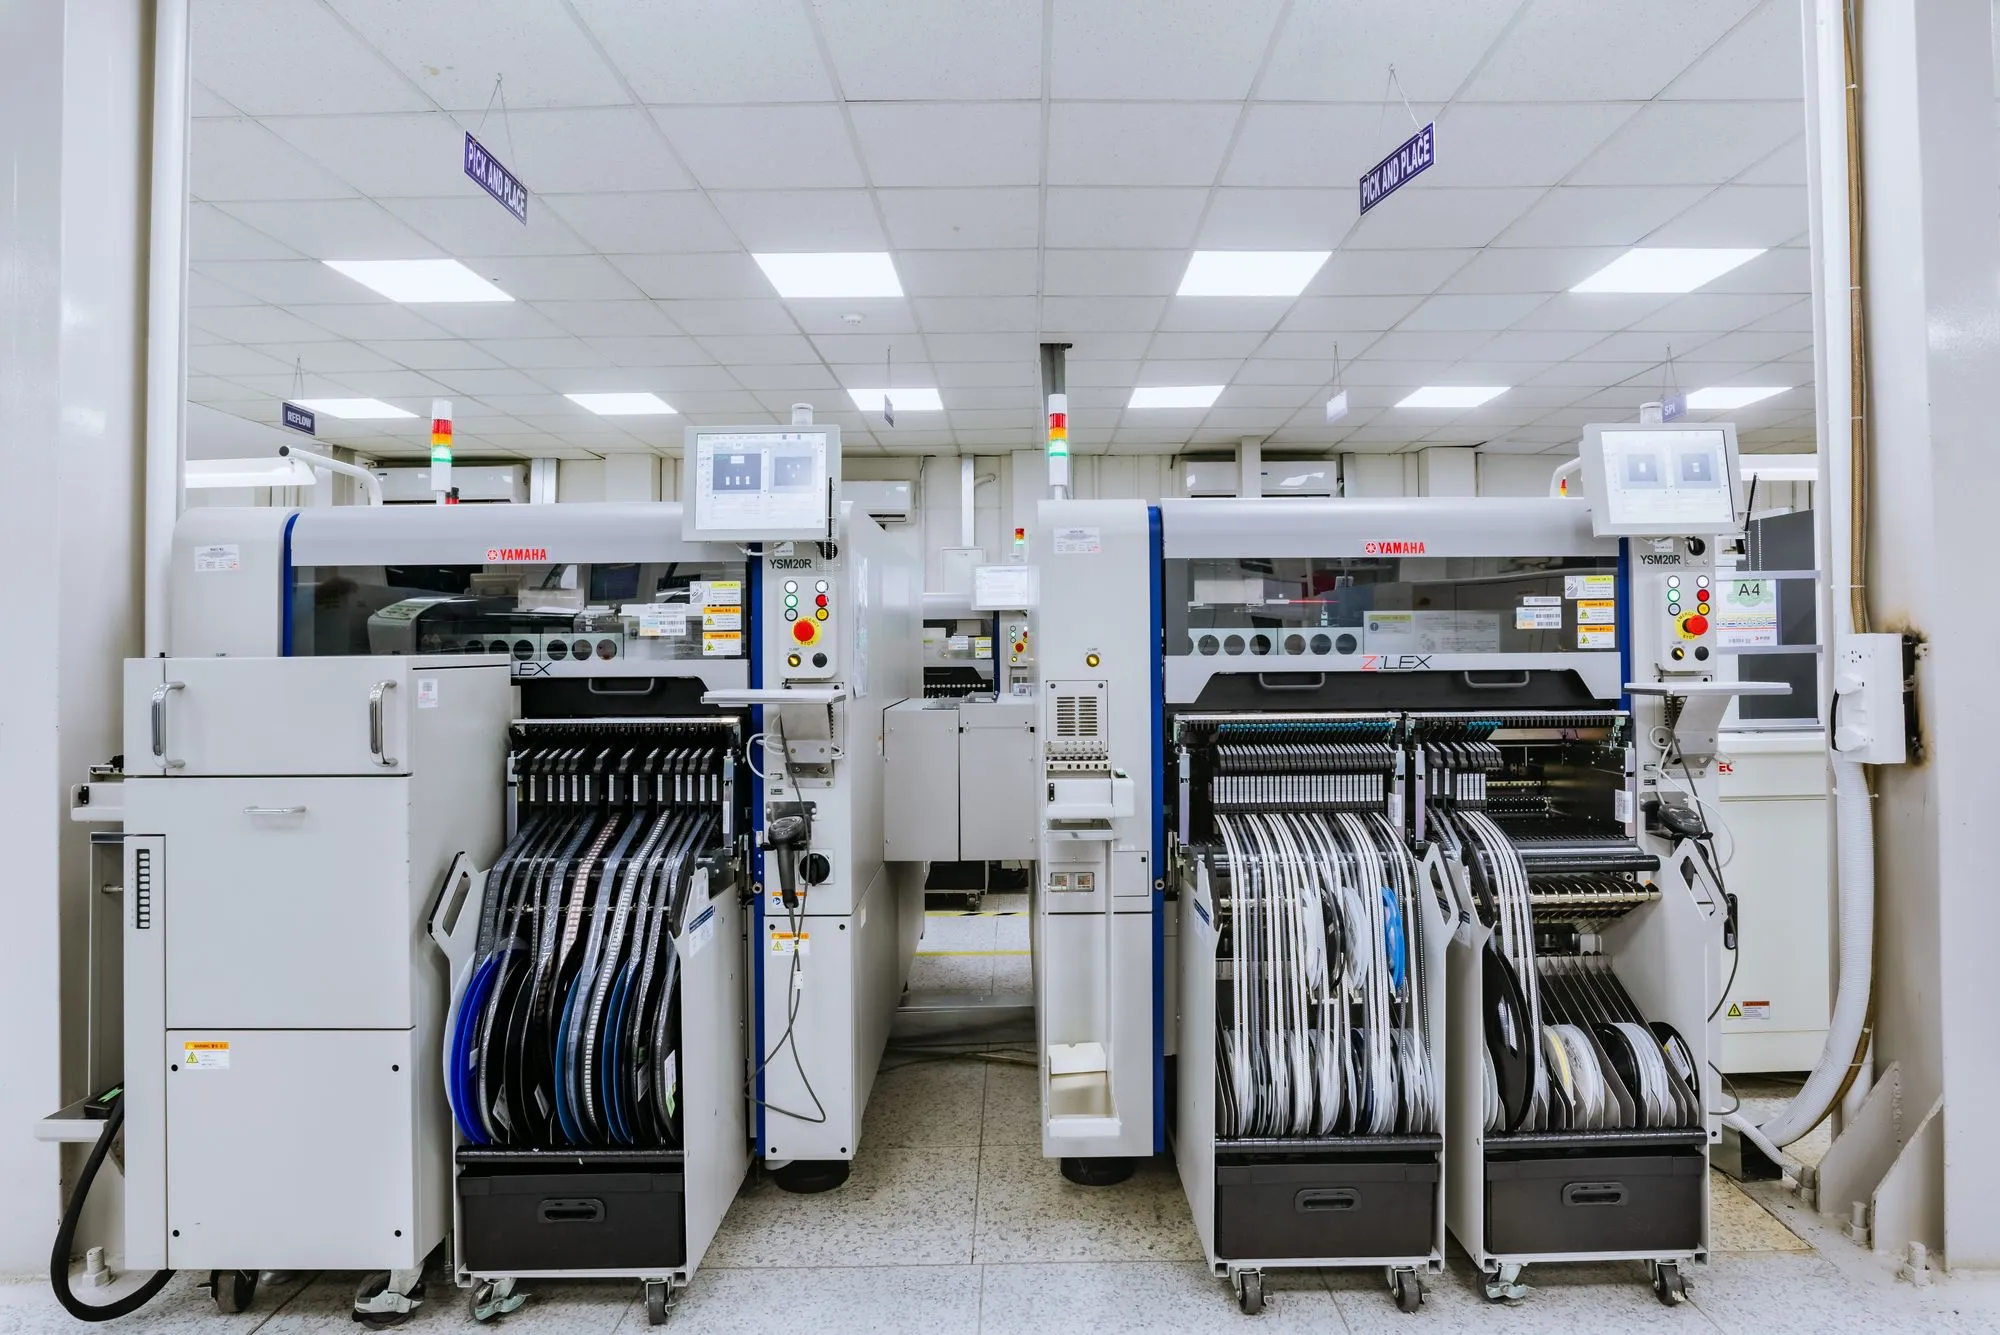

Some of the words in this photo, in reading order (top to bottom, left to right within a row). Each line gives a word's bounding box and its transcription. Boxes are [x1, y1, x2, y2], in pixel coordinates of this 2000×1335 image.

[1362, 171, 1381, 207] PICK
[1382, 157, 1400, 193] AND
[1401, 132, 1430, 178] PLACE
[468, 142, 487, 183] PICK
[487, 161, 503, 196] AND
[504, 176, 525, 218] PLACE
[1664, 400, 1675, 415] SPI
[287, 410, 312, 428] REFLOW
[500, 548, 547, 561] YAMAHA
[1378, 542, 1425, 554] YAMAHA
[769, 558, 812, 569] YSM20R
[1640, 554, 1681, 565] YSM20R
